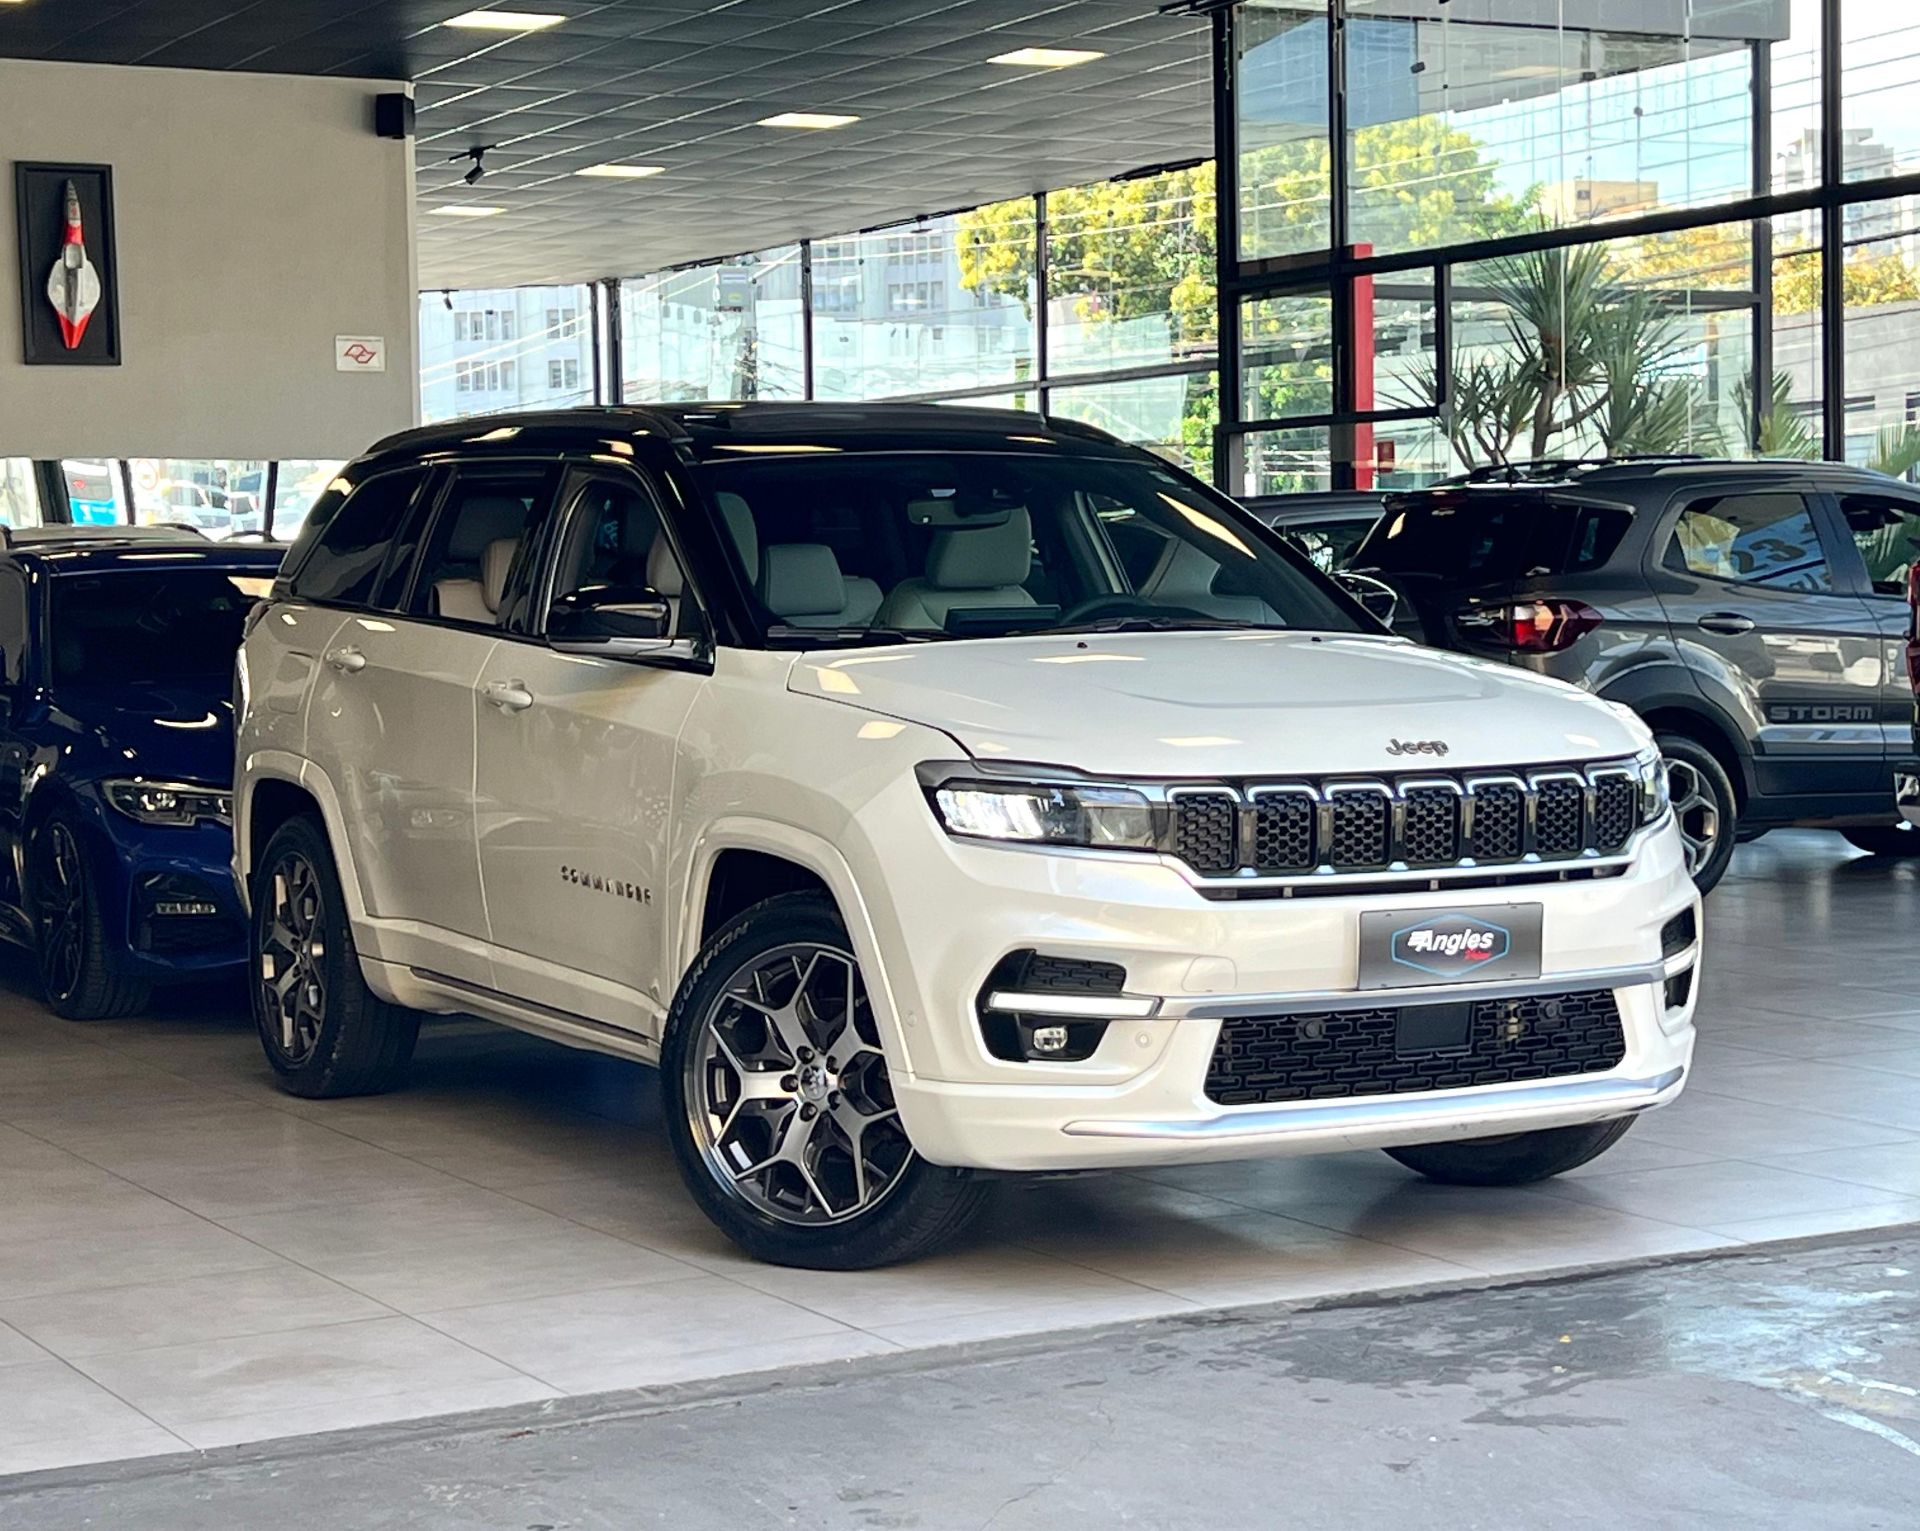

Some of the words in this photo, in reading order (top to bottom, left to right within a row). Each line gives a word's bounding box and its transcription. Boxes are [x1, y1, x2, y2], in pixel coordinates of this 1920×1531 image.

[1770, 706, 1872, 720] STORM
[1386, 739, 1449, 757] Jeep
[1408, 928, 1495, 956] Angles
[671, 921, 750, 1034] SCORPION
